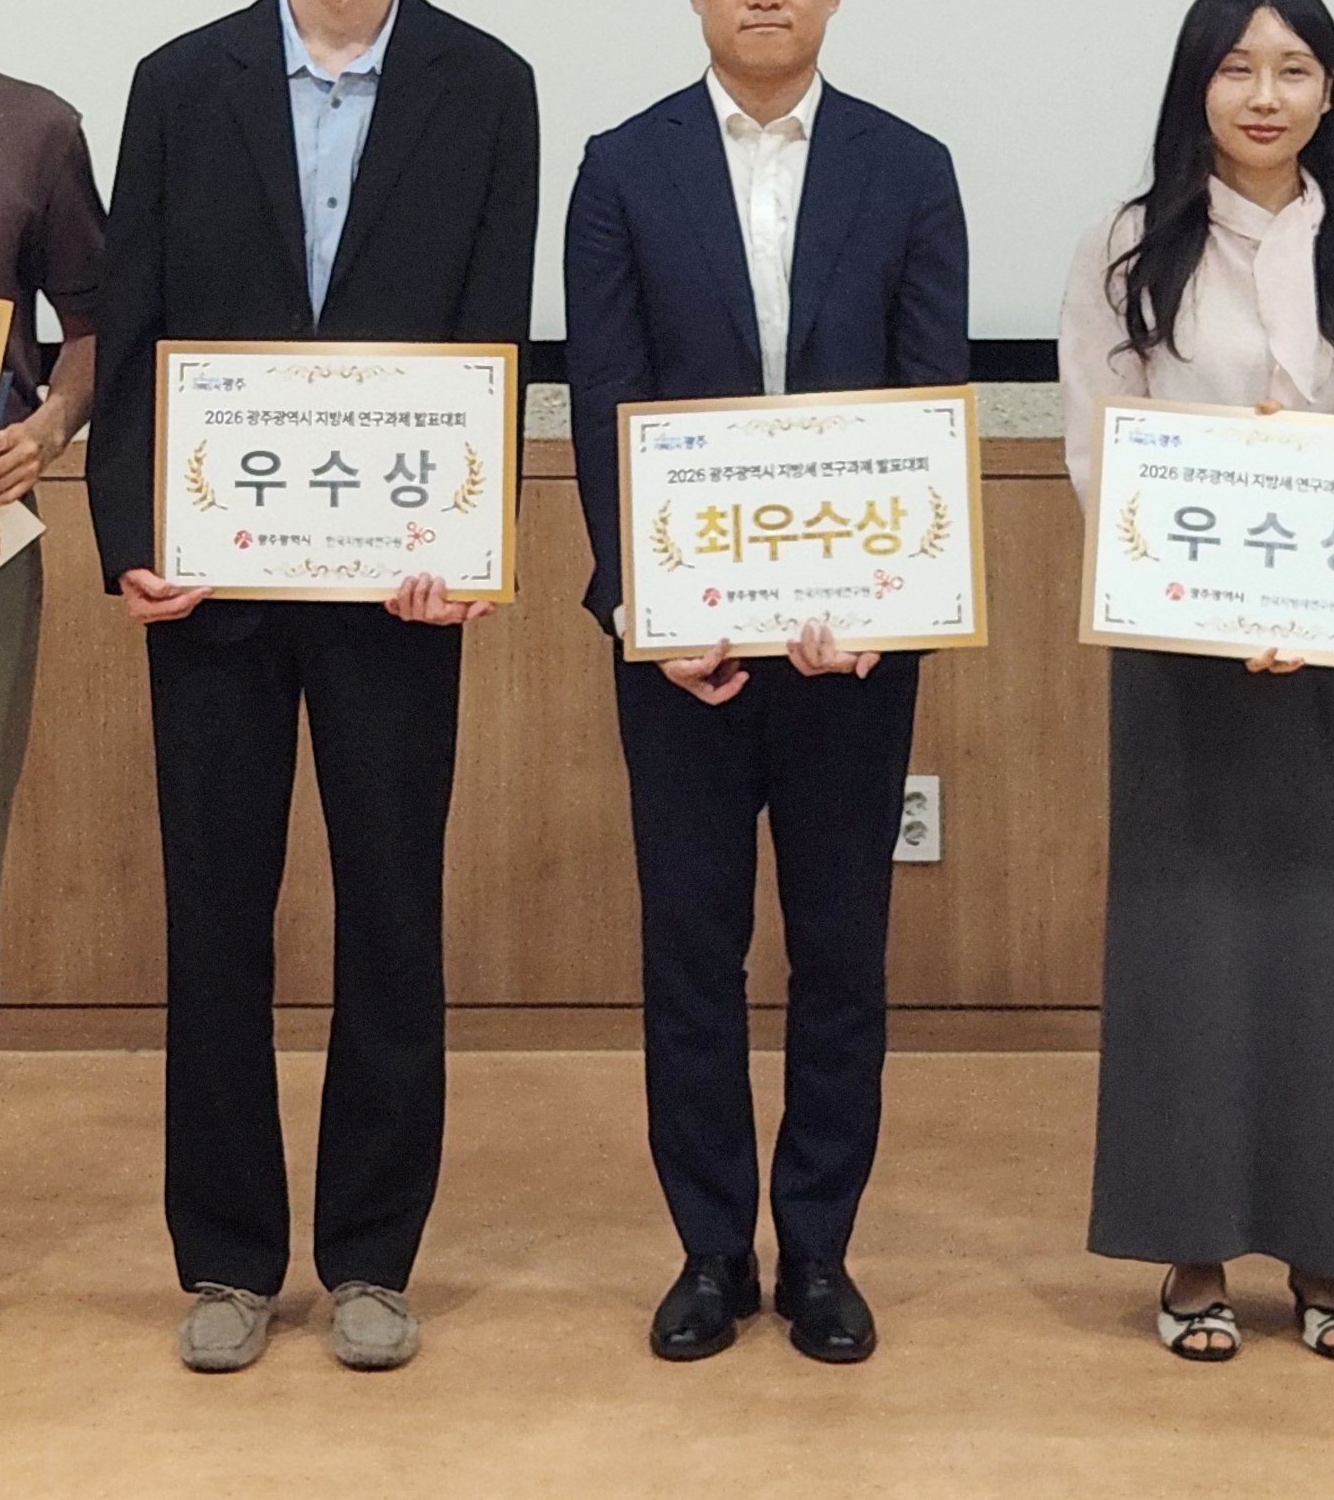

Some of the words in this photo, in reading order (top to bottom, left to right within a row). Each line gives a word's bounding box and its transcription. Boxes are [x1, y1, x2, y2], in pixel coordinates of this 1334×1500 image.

[205, 410, 244, 425] 2026
[246, 410, 312, 427] 광주광역시
[315, 411, 356, 427] 지방세
[357, 411, 411, 427] 연구과제
[414, 411, 467, 427] 발표대회
[668, 468, 706, 484] 2026
[709, 464, 775, 482] 광주광역시
[778, 461, 817, 478] 지방세
[820, 458, 873, 477] 연구과제
[876, 456, 929, 474] 발표대회
[1139, 464, 1179, 480] 2026
[1182, 467, 1248, 488] 광주광역시
[1252, 474, 1293, 491] 지방세
[694, 496, 908, 563] 최우수상
